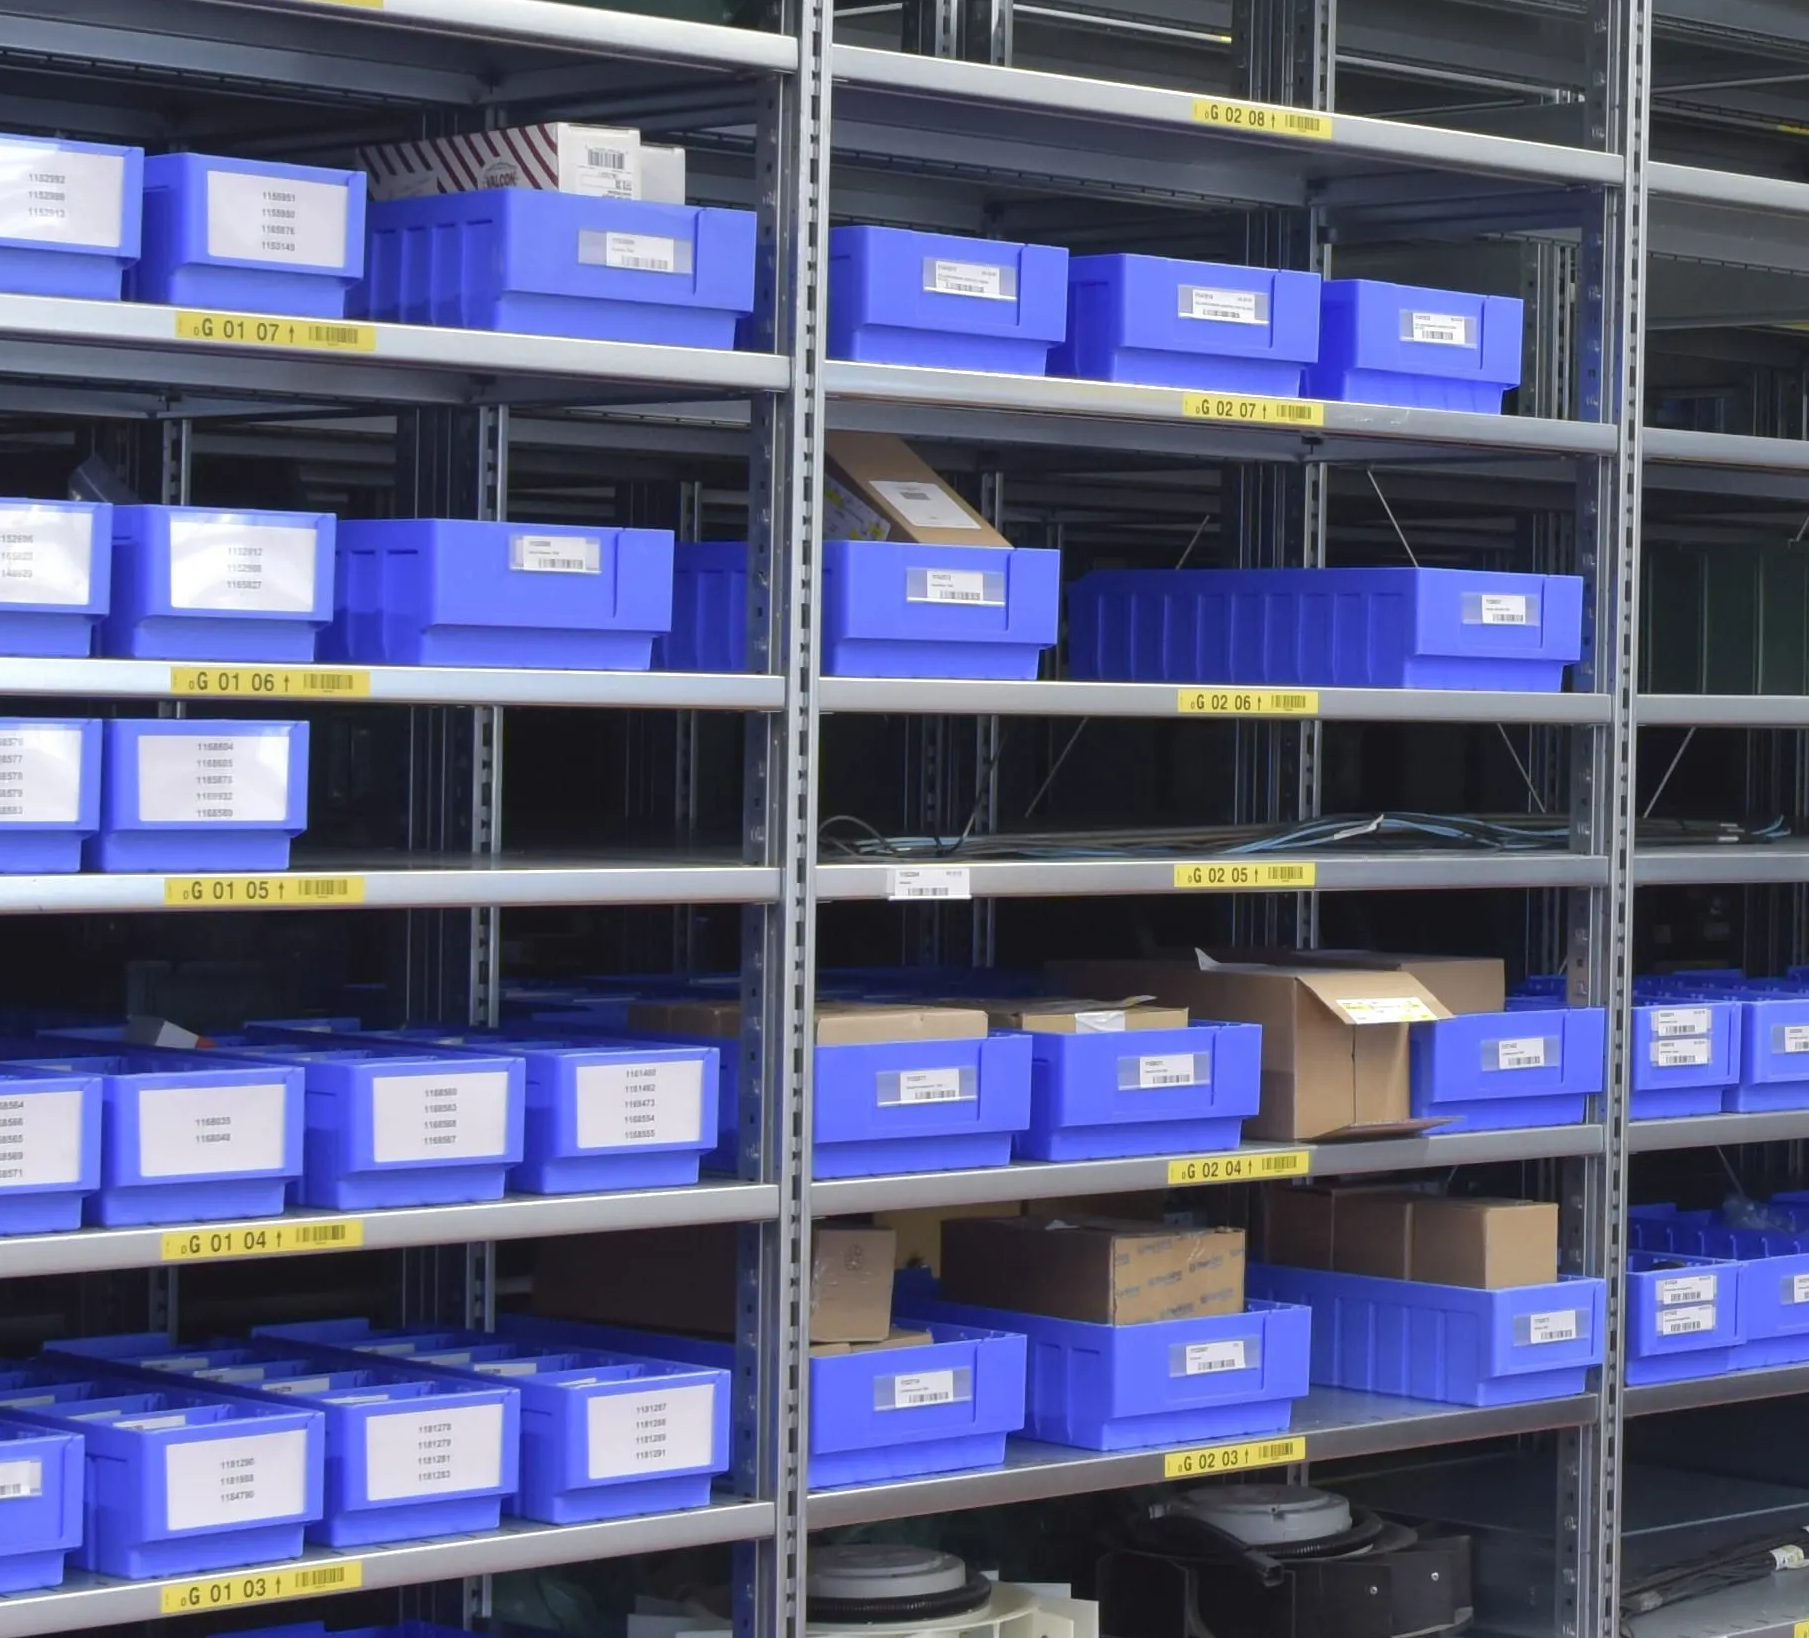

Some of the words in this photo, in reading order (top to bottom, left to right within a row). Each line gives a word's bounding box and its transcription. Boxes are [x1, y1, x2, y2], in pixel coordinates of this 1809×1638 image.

[1225, 106, 1242, 124] 02
[1248, 110, 1265, 127] 08
[223, 319, 244, 340] 01
[256, 322, 280, 342] 07
[1216, 400, 1233, 417] 02
[1239, 402, 1256, 419] 07
[218, 672, 239, 692] 01
[251, 673, 275, 692] 06
[1211, 694, 1228, 711] 02
[1234, 694, 1251, 711] 06
[1208, 867, 1225, 884] 02
[1231, 867, 1248, 883] 05
[212, 881, 234, 900] 01
[245, 881, 269, 900] 05
[1202, 1161, 1219, 1179] 02
[1225, 1160, 1242, 1177] 04
[210, 1233, 232, 1253] 01
[243, 1230, 267, 1250] 04
[1198, 1452, 1216, 1470] 02
[1221, 1449, 1239, 1467] 03
[210, 1582, 231, 1603] 01
[243, 1578, 266, 1599] 03
